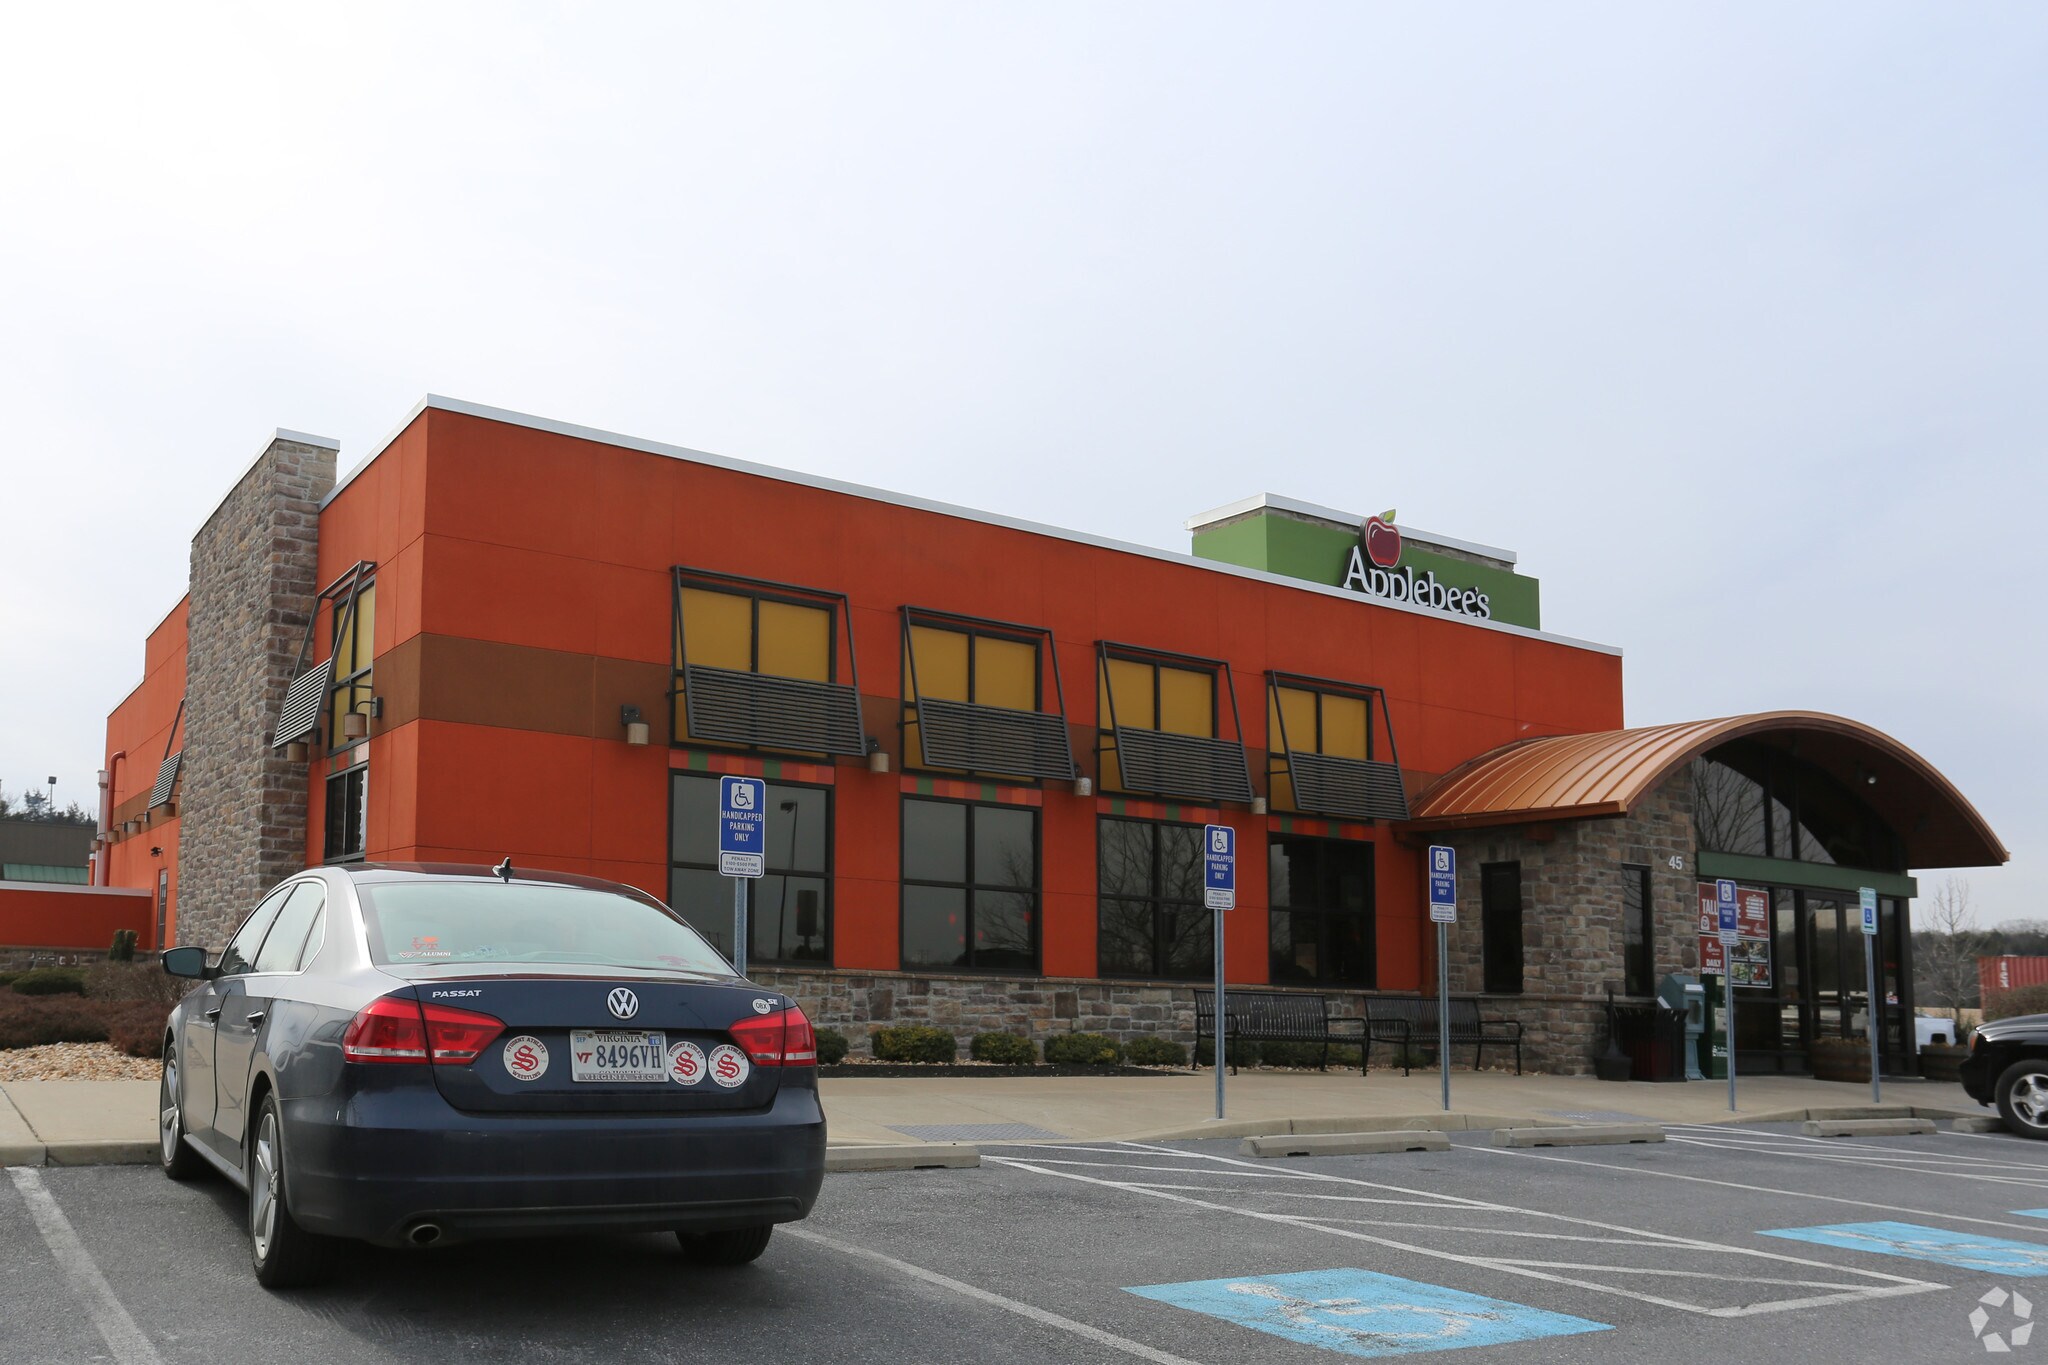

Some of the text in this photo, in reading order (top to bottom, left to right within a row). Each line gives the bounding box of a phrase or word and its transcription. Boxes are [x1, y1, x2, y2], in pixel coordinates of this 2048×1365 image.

[1343, 545, 1490, 620] Applebee's
[722, 811, 762, 821] HANDICAPPED
[729, 822, 755, 831] PARKING
[734, 833, 750, 841] ONLY
[1207, 854, 1233, 863] HANDICAPPED
[1668, 855, 1683, 870] 45
[1211, 863, 1228, 871] PARKING
[1701, 899, 1718, 916] TALL
[1706, 958, 1721, 967] DAILY
[432, 989, 482, 998] PASSAT
[755, 1002, 768, 1010] OBX
[767, 998, 778, 1006] SE
[596, 1035, 642, 1043] VIRGINIA
[506, 1037, 546, 1054] STUDENT ATHLETE
[668, 1042, 704, 1059] STUDENT ATHLETE
[709, 1045, 745, 1062] STUDENT ATHLETE
[576, 1052, 593, 1064] VT
[596, 1045, 662, 1068] 8496VH
[512, 1070, 541, 1080] WRESTLING
[677, 1077, 697, 1085] SOCCER
[717, 1078, 742, 1087] FOOTBALL
